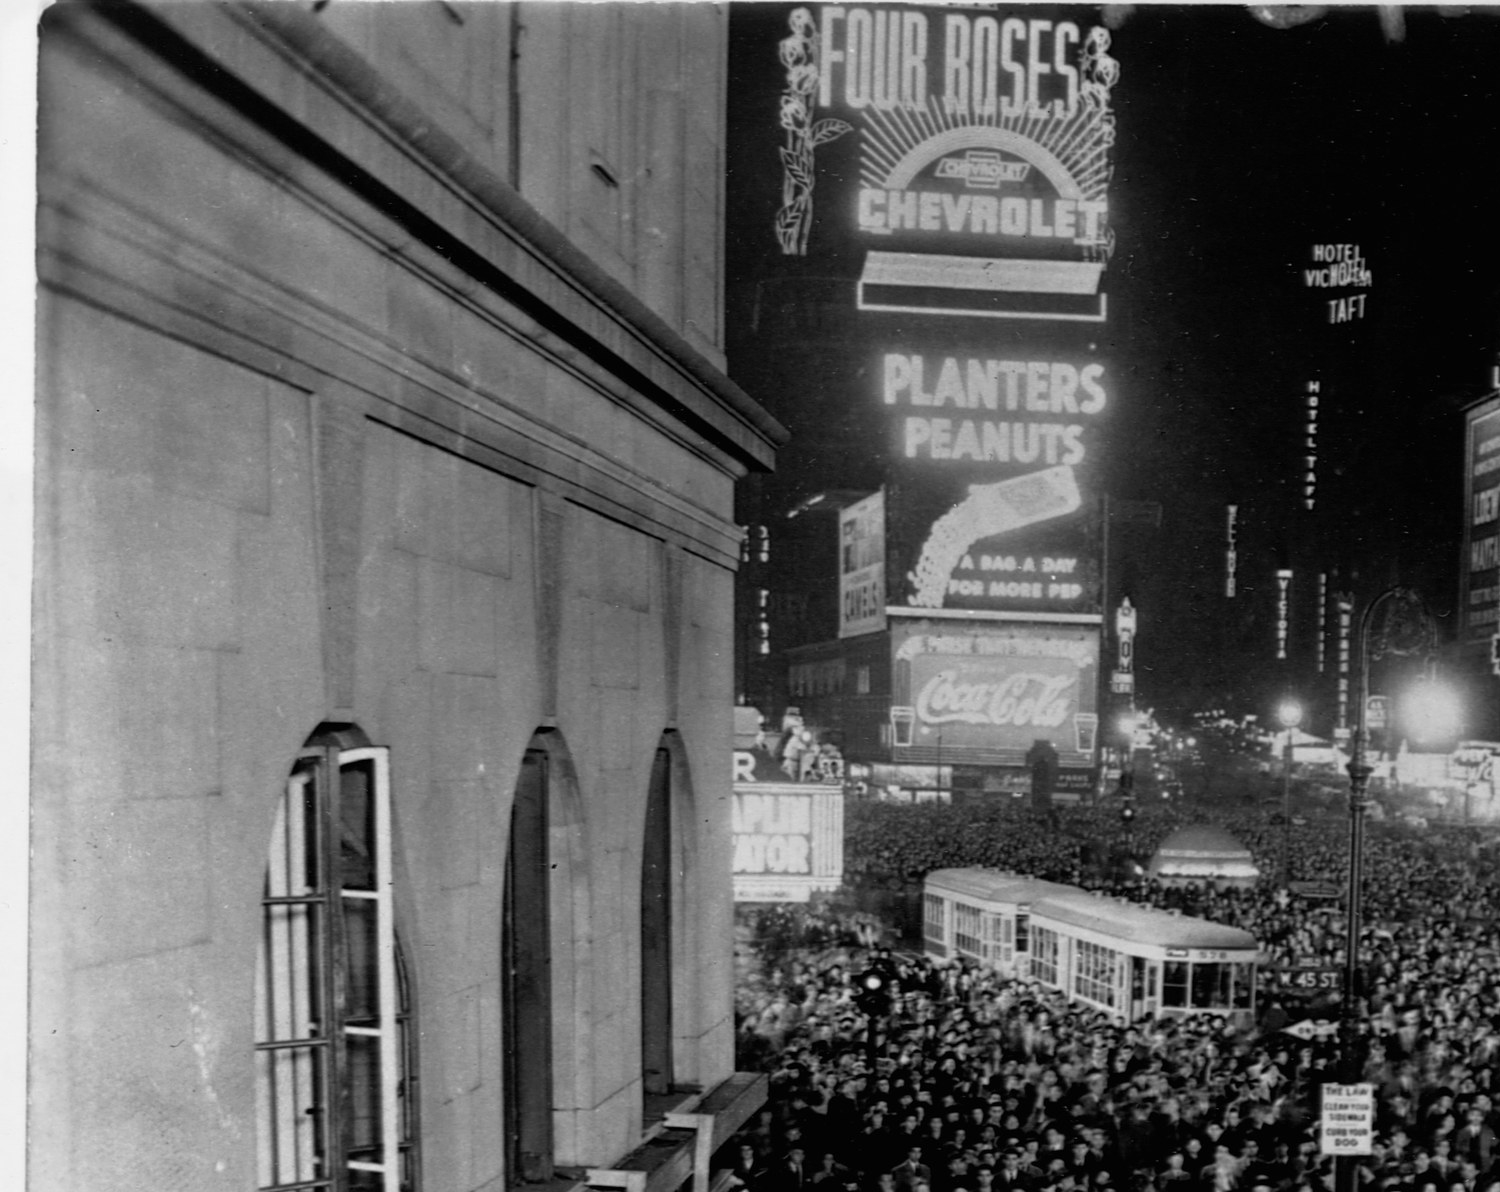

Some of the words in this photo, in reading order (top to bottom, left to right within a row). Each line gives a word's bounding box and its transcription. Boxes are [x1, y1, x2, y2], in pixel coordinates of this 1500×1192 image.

[819, 7, 929, 113] FOUR
[945, 13, 1081, 121] ROSES
[943, 158, 1026, 181] CHEVROLET
[858, 188, 1108, 239] CHEVROLET
[1313, 243, 1360, 263] HOTEL
[1328, 294, 1367, 324] TAFT
[883, 354, 1107, 416] PLANTERS
[1307, 380, 1320, 448] HOTEL
[905, 417, 1085, 466] PEANUTS
[1304, 455, 1317, 510] TAFT
[959, 554, 975, 570] A
[980, 554, 1017, 572] BAG
[1022, 556, 1036, 573] A
[1041, 557, 1078, 573] DAY
[948, 579, 984, 596] FOR
[989, 581, 1043, 599] MORE
[1048, 583, 1083, 600] PEP
[917, 669, 1078, 728] Coca-Cola
[732, 836, 810, 874] ATOR
[1296, 971, 1317, 988] 45
[1326, 1086, 1343, 1096] THE
[1346, 1087, 1369, 1096] LAW
[1334, 1138, 1358, 1147] DOG
